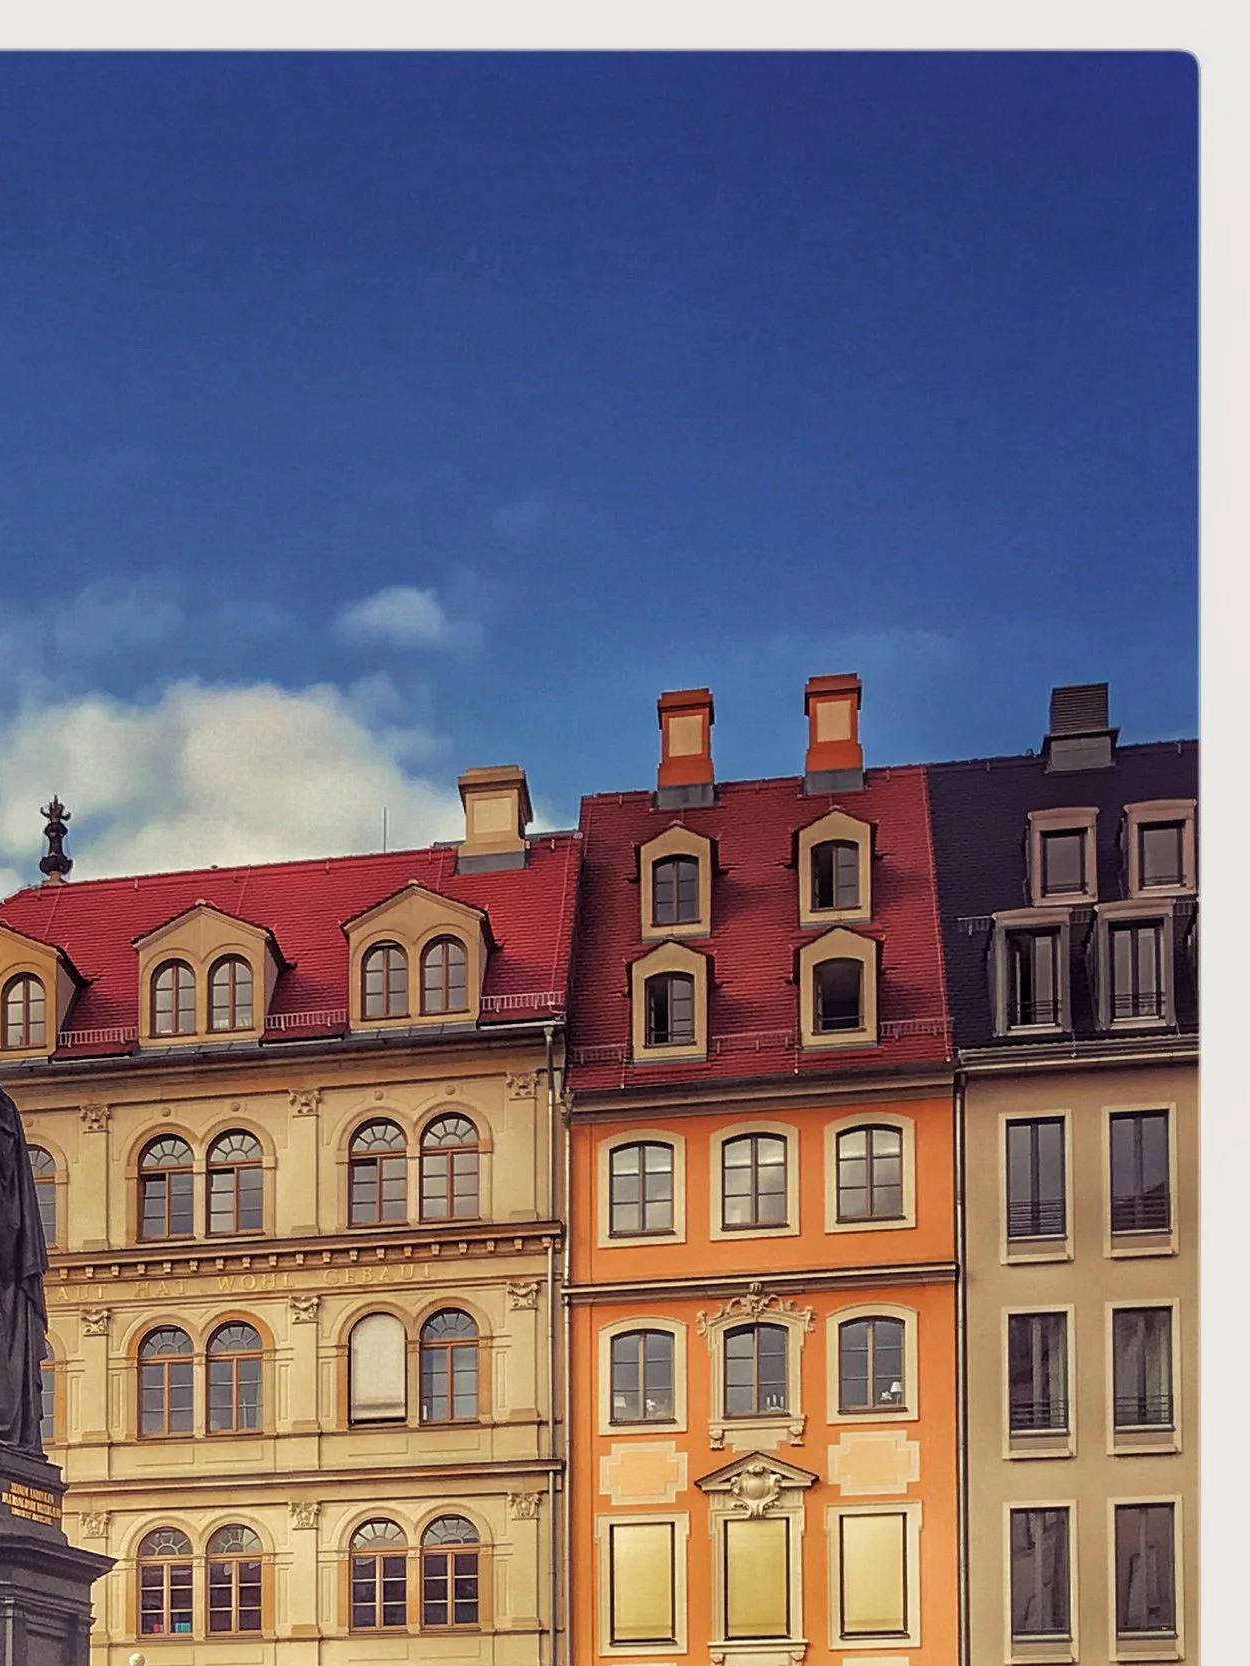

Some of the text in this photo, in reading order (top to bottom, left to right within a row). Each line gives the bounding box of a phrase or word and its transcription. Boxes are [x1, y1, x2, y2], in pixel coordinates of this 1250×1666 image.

[133, 1280, 189, 1297] HAT
[216, 1272, 295, 1292] WOHL
[323, 1263, 434, 1286] GEBAUT
